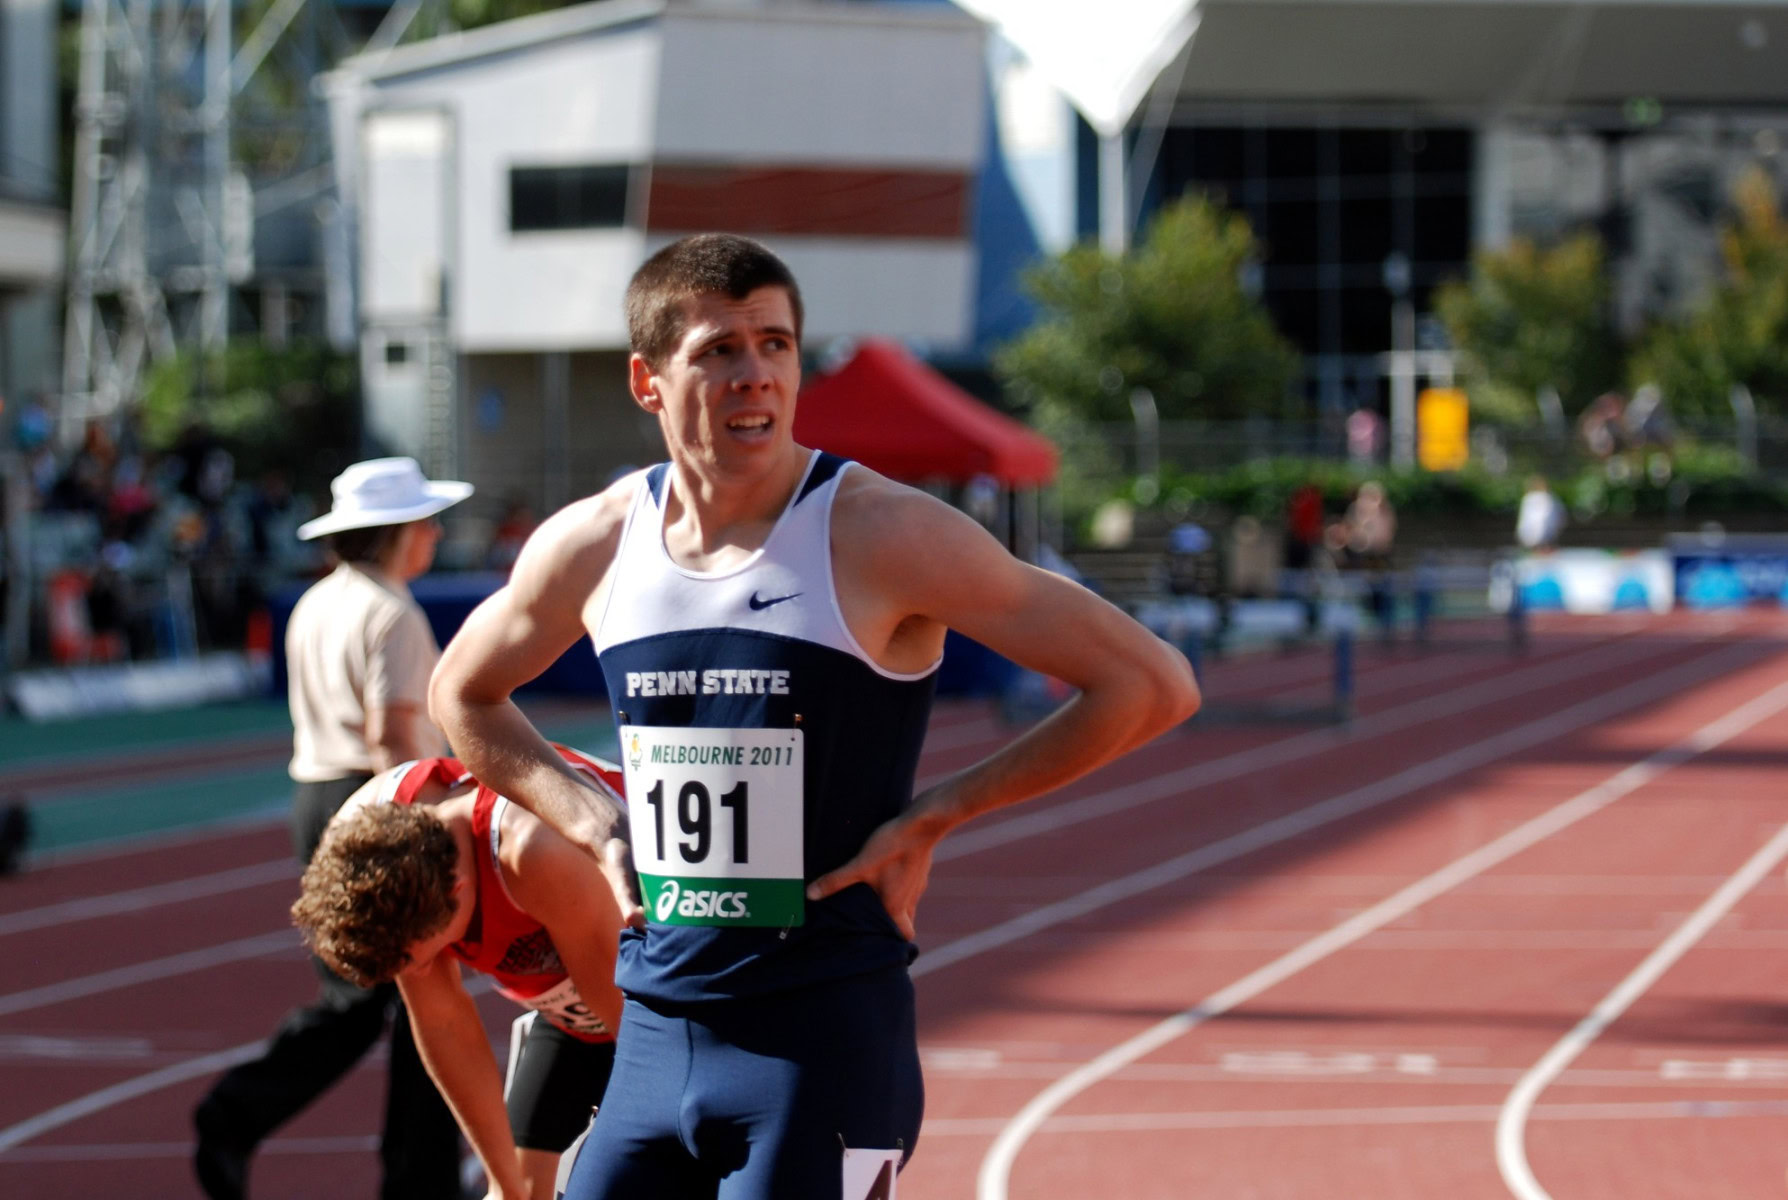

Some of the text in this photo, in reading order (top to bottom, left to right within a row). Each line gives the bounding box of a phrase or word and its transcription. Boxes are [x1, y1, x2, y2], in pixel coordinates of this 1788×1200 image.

[626, 669, 790, 697] PENN STATE
[651, 745, 793, 765] MELBOURNE 2011
[646, 779, 749, 864] 191
